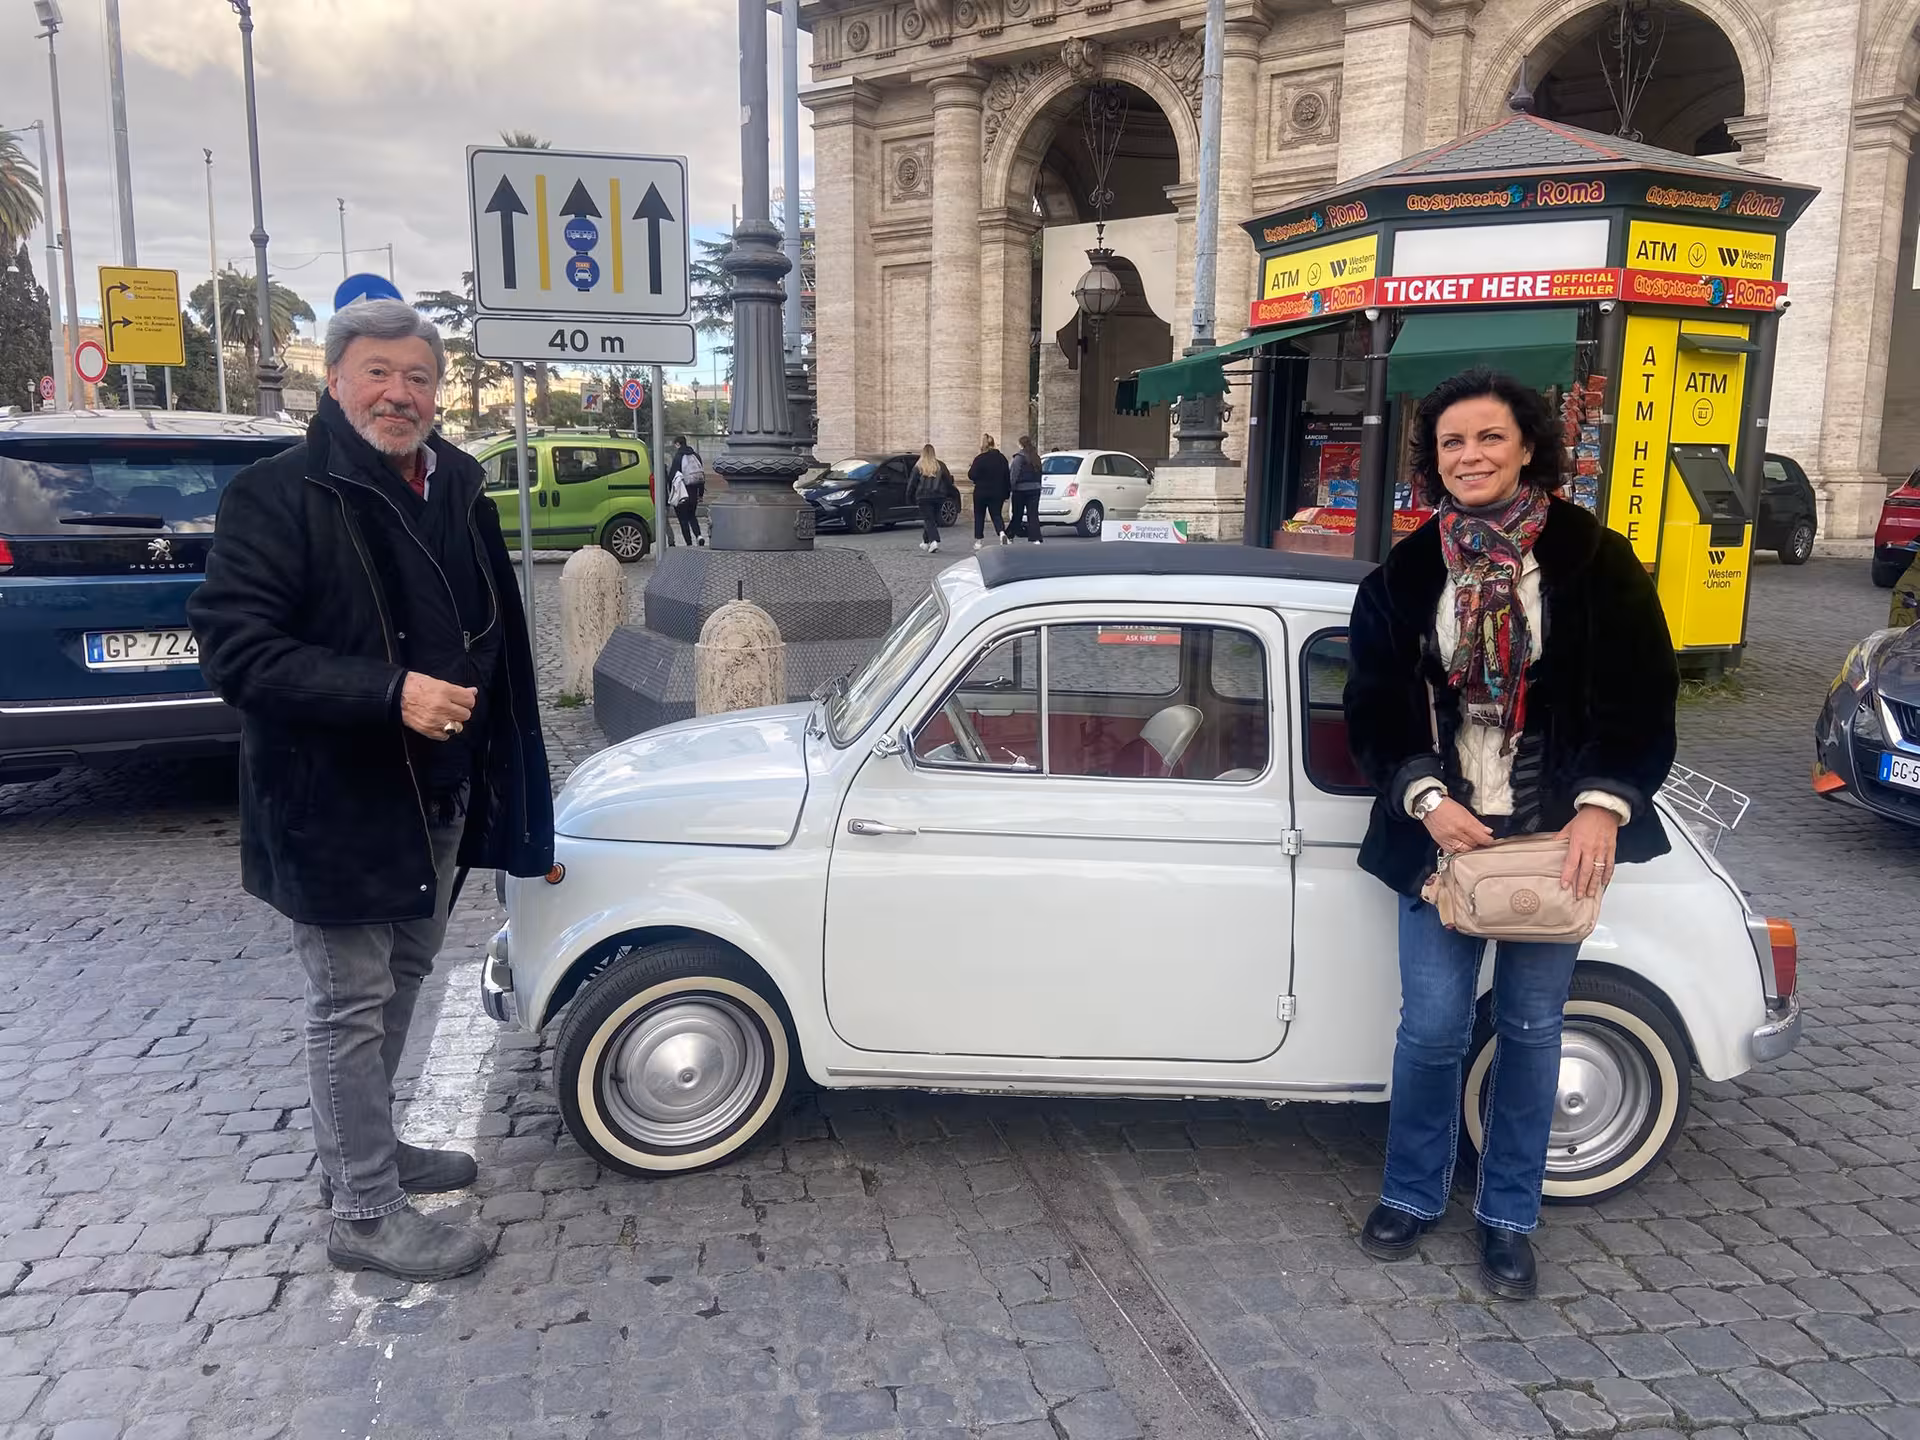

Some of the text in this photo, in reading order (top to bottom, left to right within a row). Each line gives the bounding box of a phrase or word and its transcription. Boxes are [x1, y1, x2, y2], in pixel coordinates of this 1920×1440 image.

[1407, 191, 1510, 211] CitySightseeing
[1636, 239, 1677, 262] ATM
[1741, 249, 1772, 262] Western
[1349, 254, 1375, 266] Western
[1740, 260, 1762, 270] Union
[1348, 265, 1367, 276] Union
[1272, 269, 1299, 291] ATM
[1553, 273, 1615, 284] OFFICIAL
[1384, 275, 1550, 302] TICKET HERE
[1552, 285, 1614, 296] RETAILER
[1634, 275, 1713, 300] CitySightseeing
[548, 329, 625, 354] 40 m
[1685, 372, 1728, 394] ATM
[1628, 346, 1656, 541] ATM HERE
[1118, 531, 1169, 540] EXPERIENCE
[1135, 525, 1169, 534] Sightseeing
[1708, 569, 1741, 579] Western
[1706, 579, 1731, 589] Union
